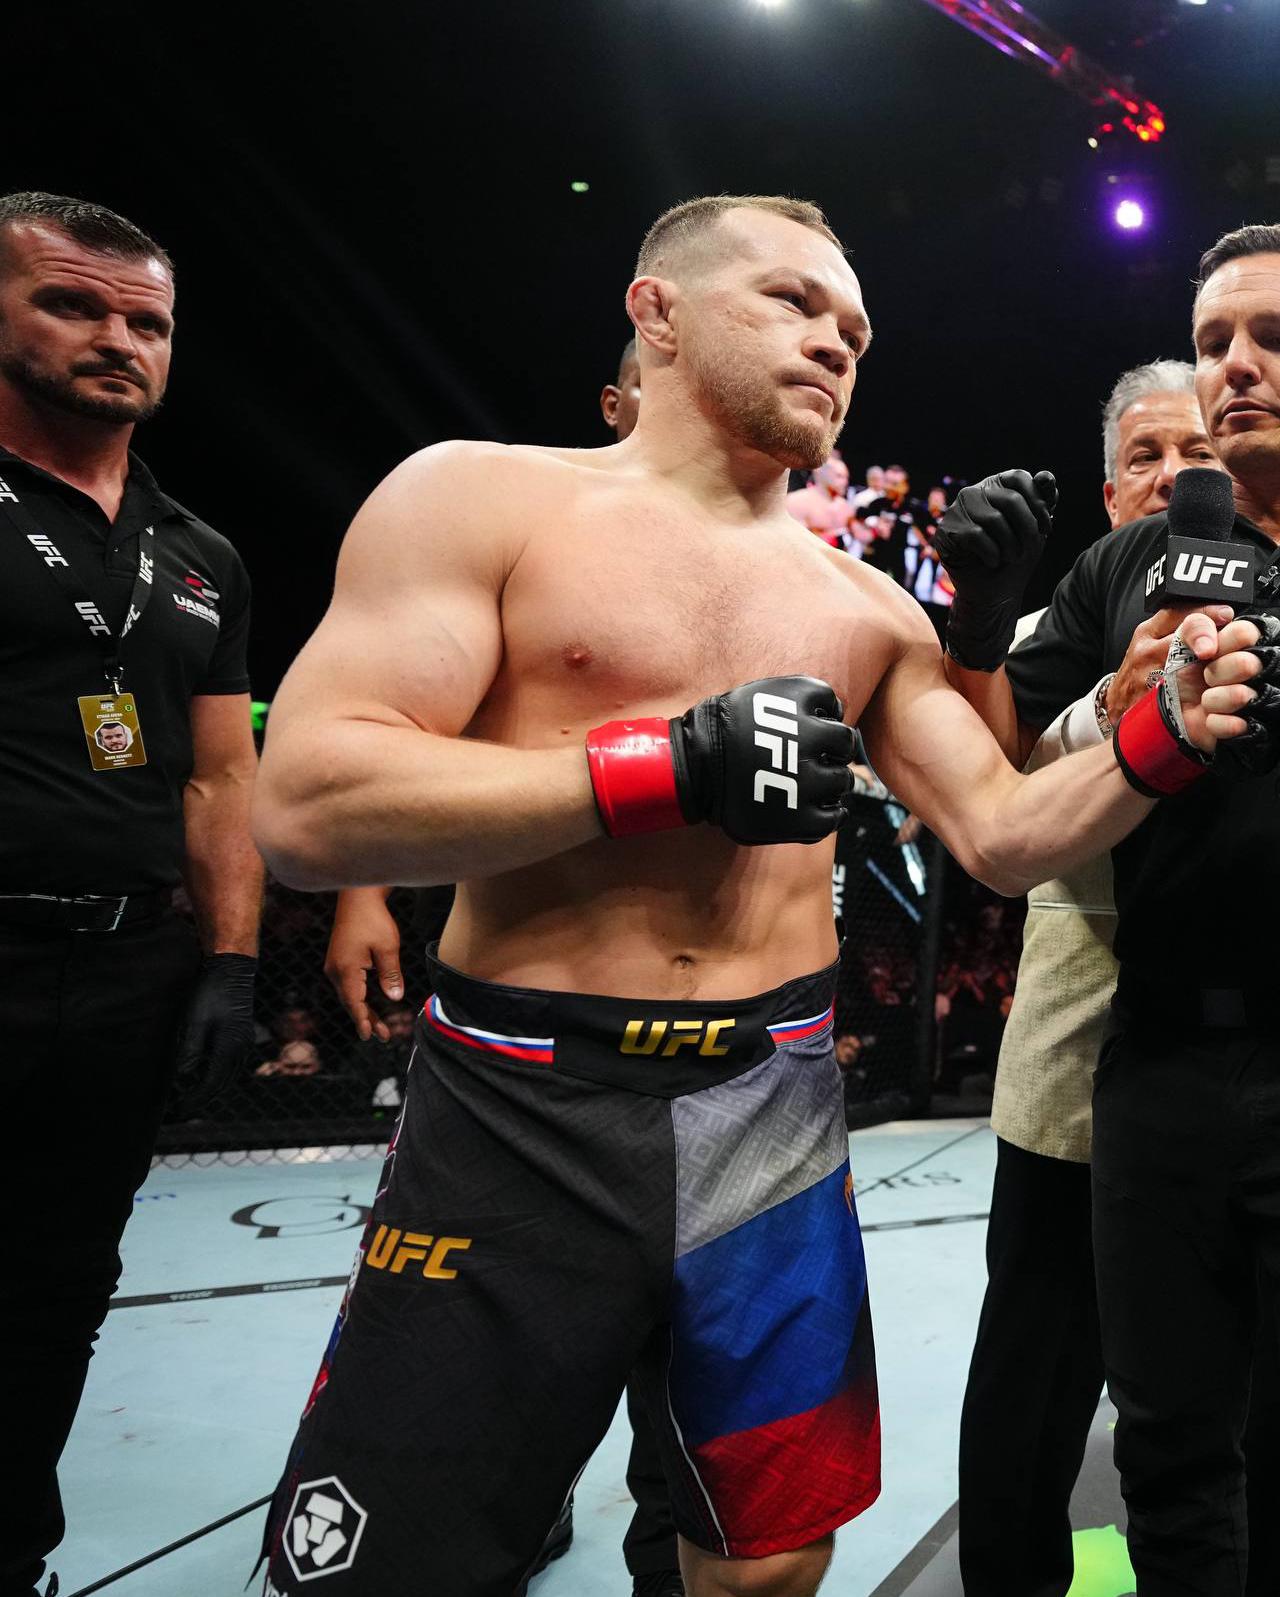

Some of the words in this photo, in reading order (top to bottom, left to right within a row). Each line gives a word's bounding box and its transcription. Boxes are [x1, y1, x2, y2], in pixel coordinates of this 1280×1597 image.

[27, 534, 69, 567] UFC
[138, 551, 154, 585] UFC
[1145, 553, 1167, 597] UFC
[1173, 552, 1249, 588] UFC
[75, 601, 112, 636] UFC
[753, 692, 799, 810] UFC
[618, 1018, 736, 1057] UFC
[365, 1224, 472, 1280] UFC
